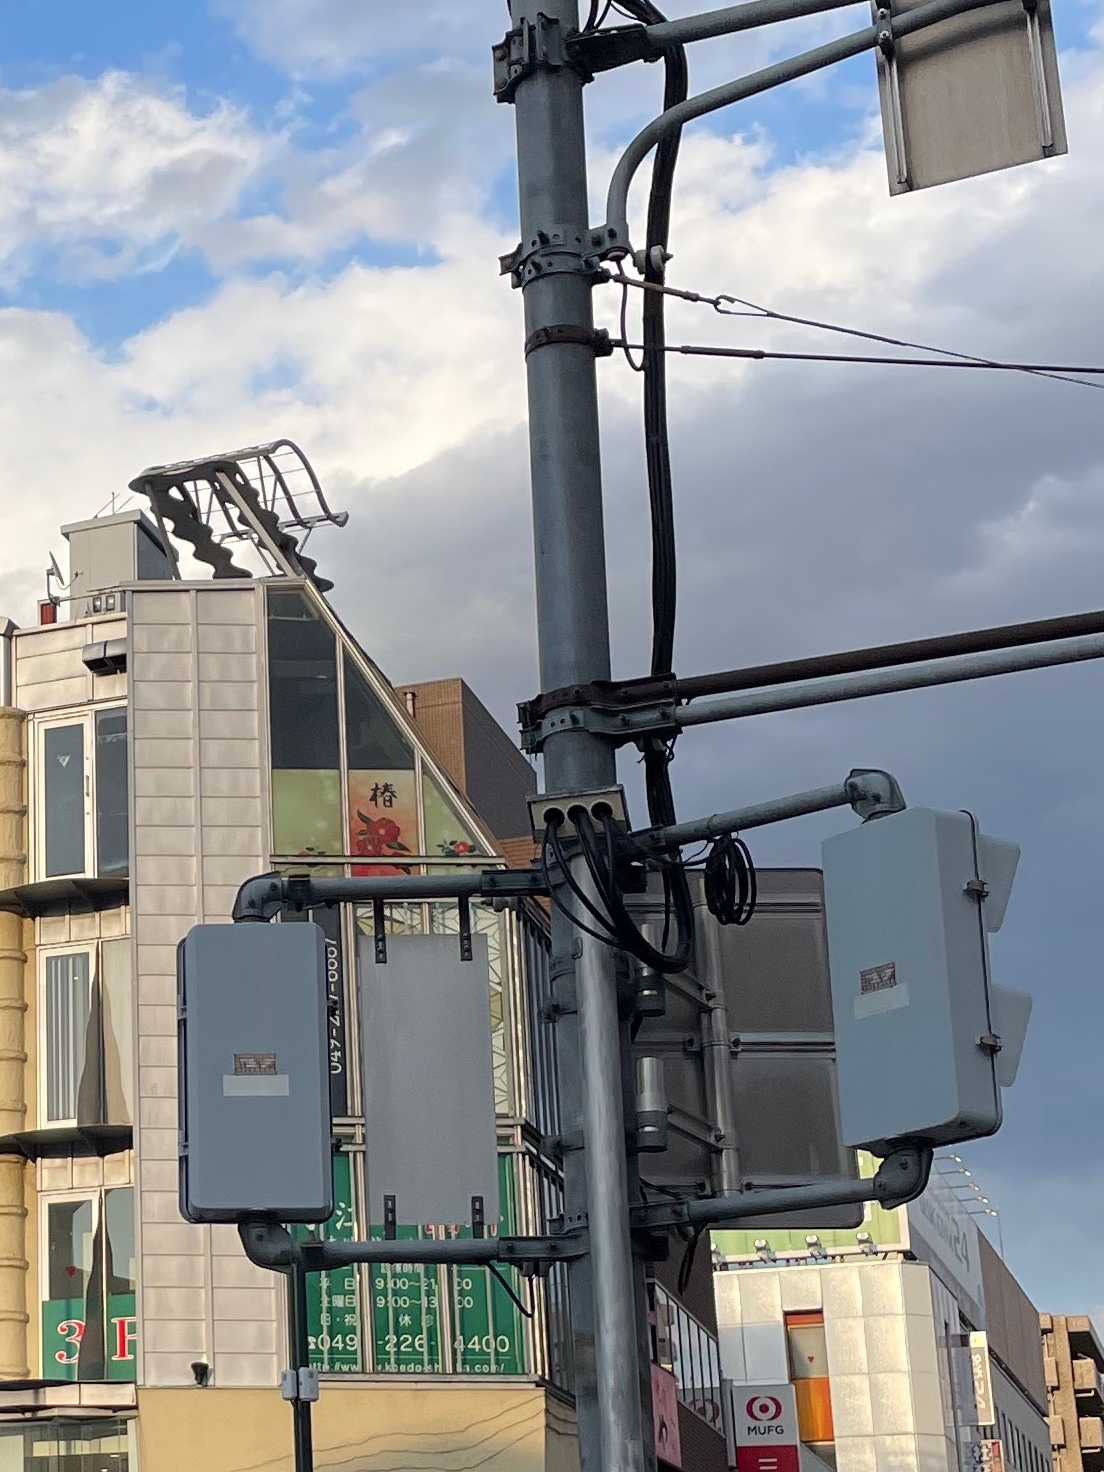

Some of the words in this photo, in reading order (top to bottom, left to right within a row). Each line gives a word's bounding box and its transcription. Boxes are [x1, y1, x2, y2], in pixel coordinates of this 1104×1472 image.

[369, 782, 397, 808] 椿
[325, 937, 342, 1075] 049-21-0001
[747, 1425, 784, 1436] MUFG
